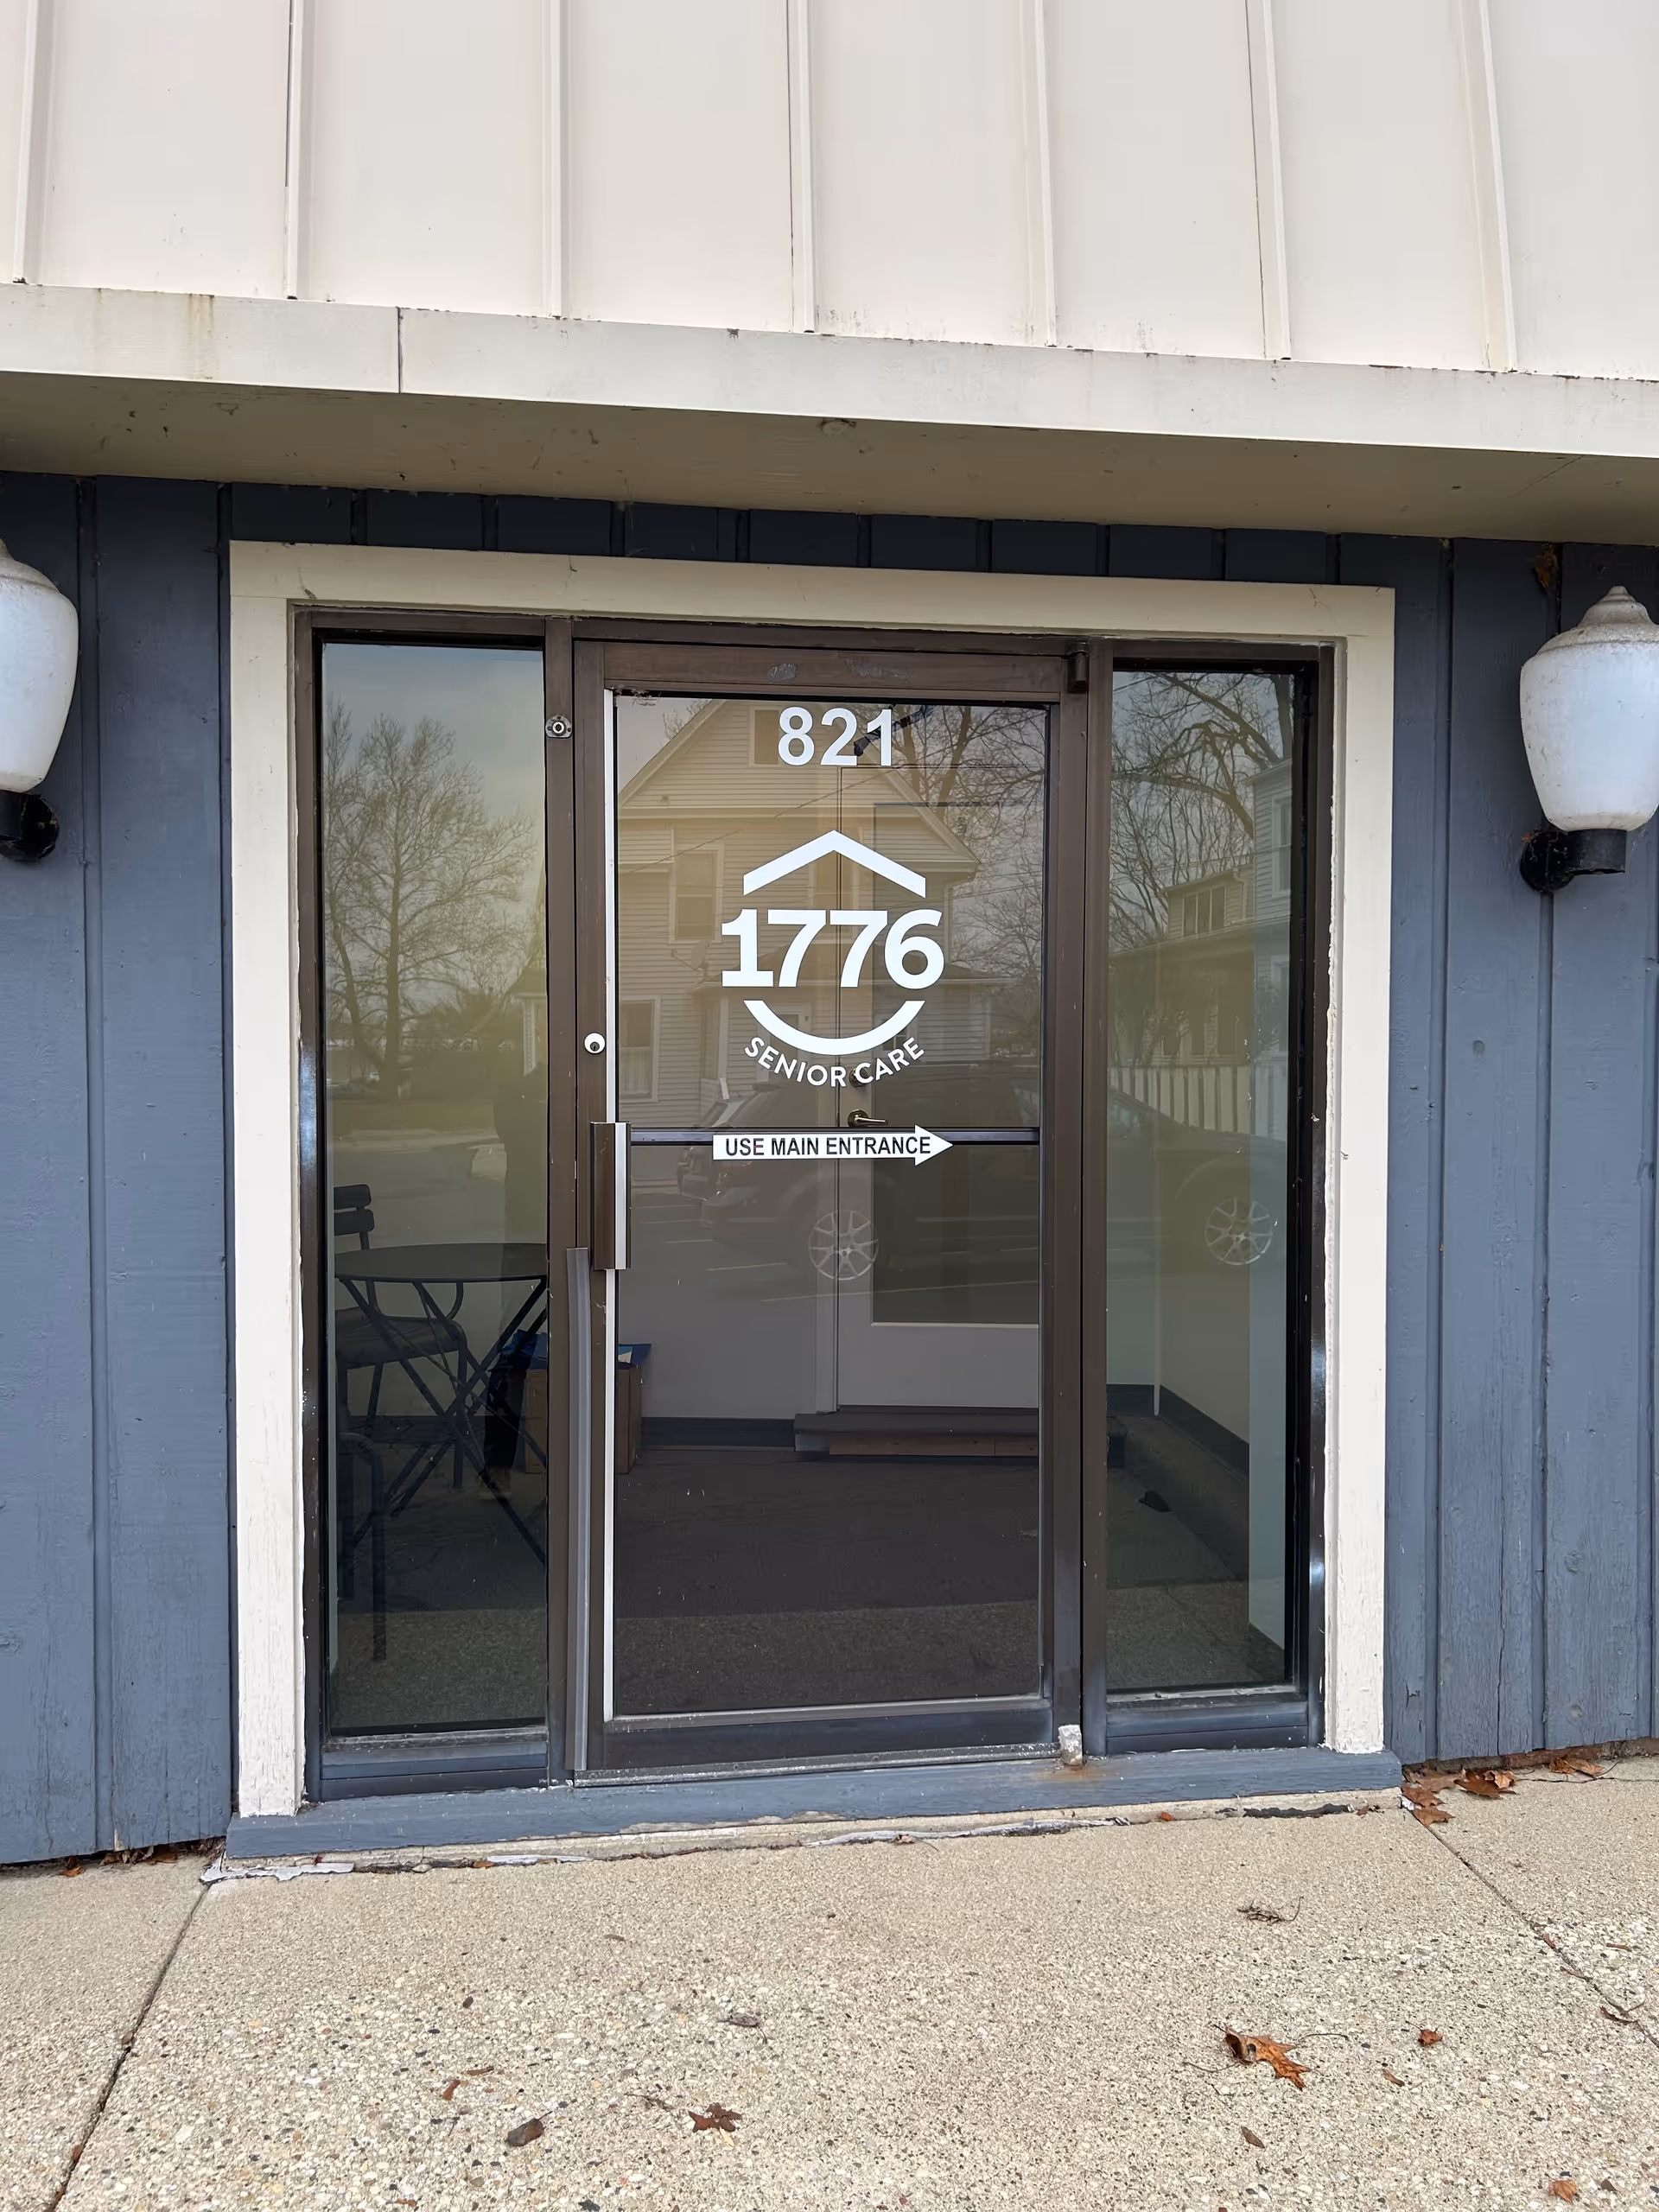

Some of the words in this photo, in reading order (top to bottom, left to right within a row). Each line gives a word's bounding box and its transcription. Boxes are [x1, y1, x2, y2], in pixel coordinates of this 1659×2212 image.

[778, 706, 893, 766] 821
[721, 908, 944, 989] 1776
[744, 1036, 848, 1088] SENIOR
[852, 1036, 925, 1085] CARE
[725, 1138, 765, 1157] USE
[771, 1137, 819, 1156] MAIN
[826, 1136, 931, 1155] ENTRANCE
